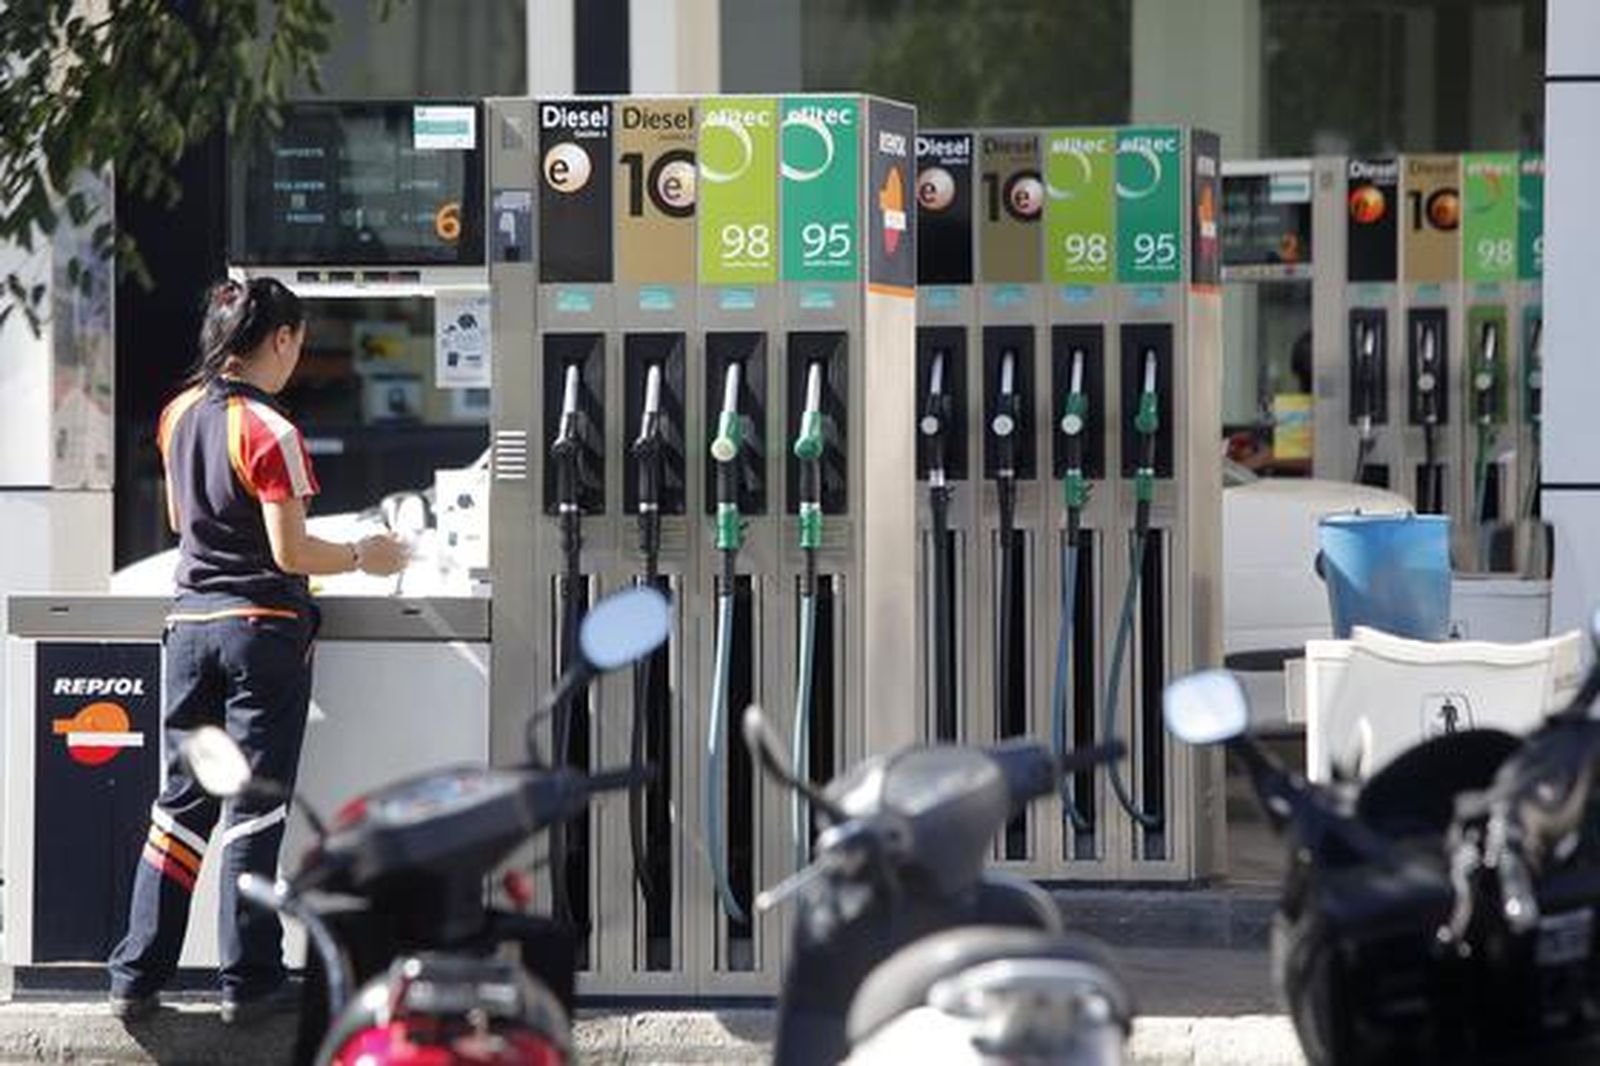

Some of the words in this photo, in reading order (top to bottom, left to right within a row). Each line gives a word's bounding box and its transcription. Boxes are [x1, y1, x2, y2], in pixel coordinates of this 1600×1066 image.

[542, 105, 609, 128] Diesel
[622, 106, 693, 129] Diesel
[915, 136, 970, 156] Diesel
[436, 203, 461, 240] 6
[721, 224, 769, 259] 98
[802, 223, 850, 258] 95
[1065, 233, 1107, 264] 98
[1134, 233, 1175, 264] 95
[1478, 239, 1513, 265] 98
[53, 678, 144, 695] REPSOL
